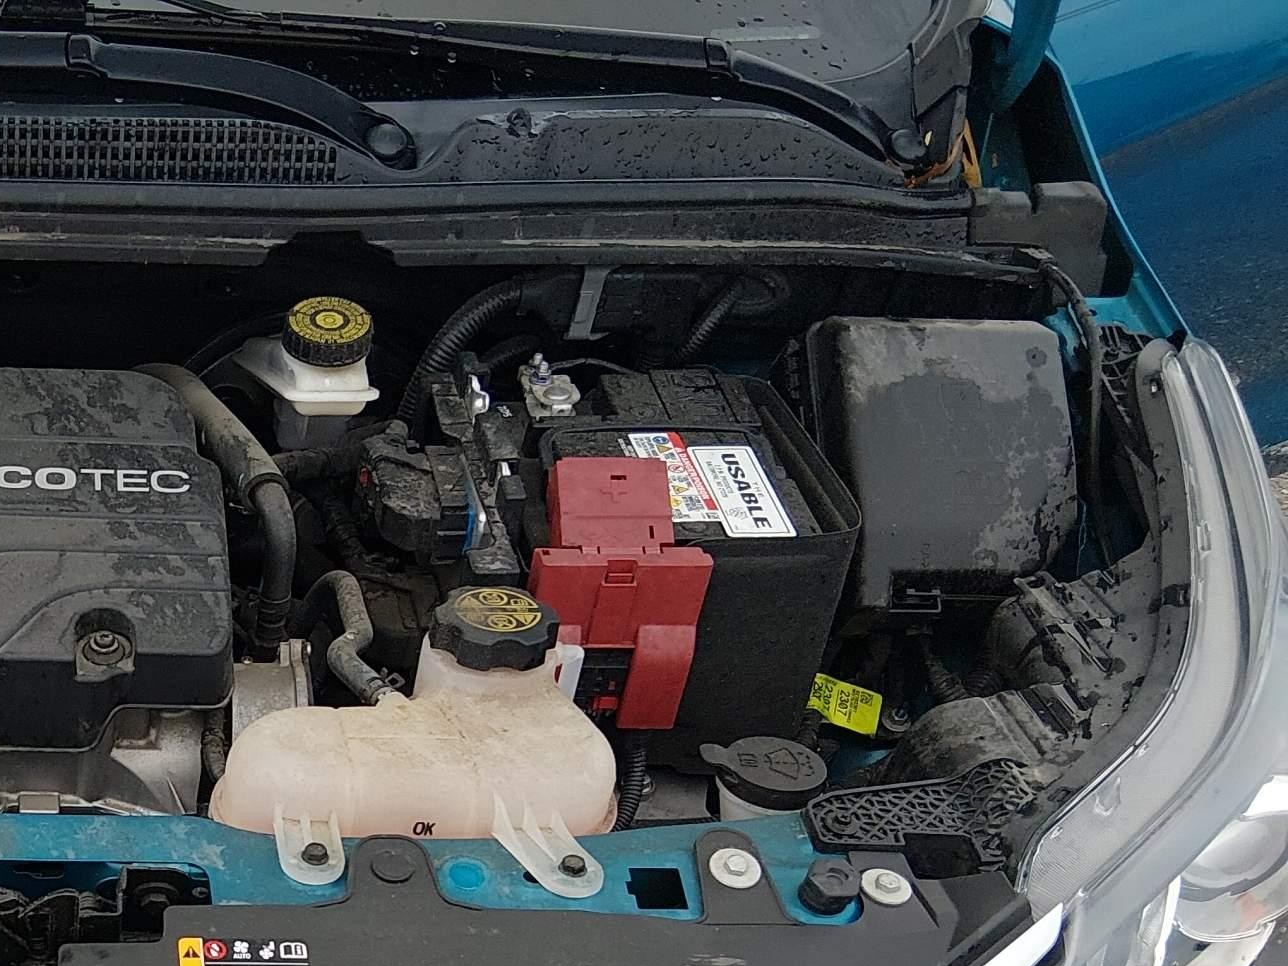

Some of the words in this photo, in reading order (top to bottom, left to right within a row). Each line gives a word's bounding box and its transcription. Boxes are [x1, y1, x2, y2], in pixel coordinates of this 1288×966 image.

[721, 453, 772, 529] USABLE
[836, 689, 851, 717] 2307
[413, 821, 437, 836] OK
